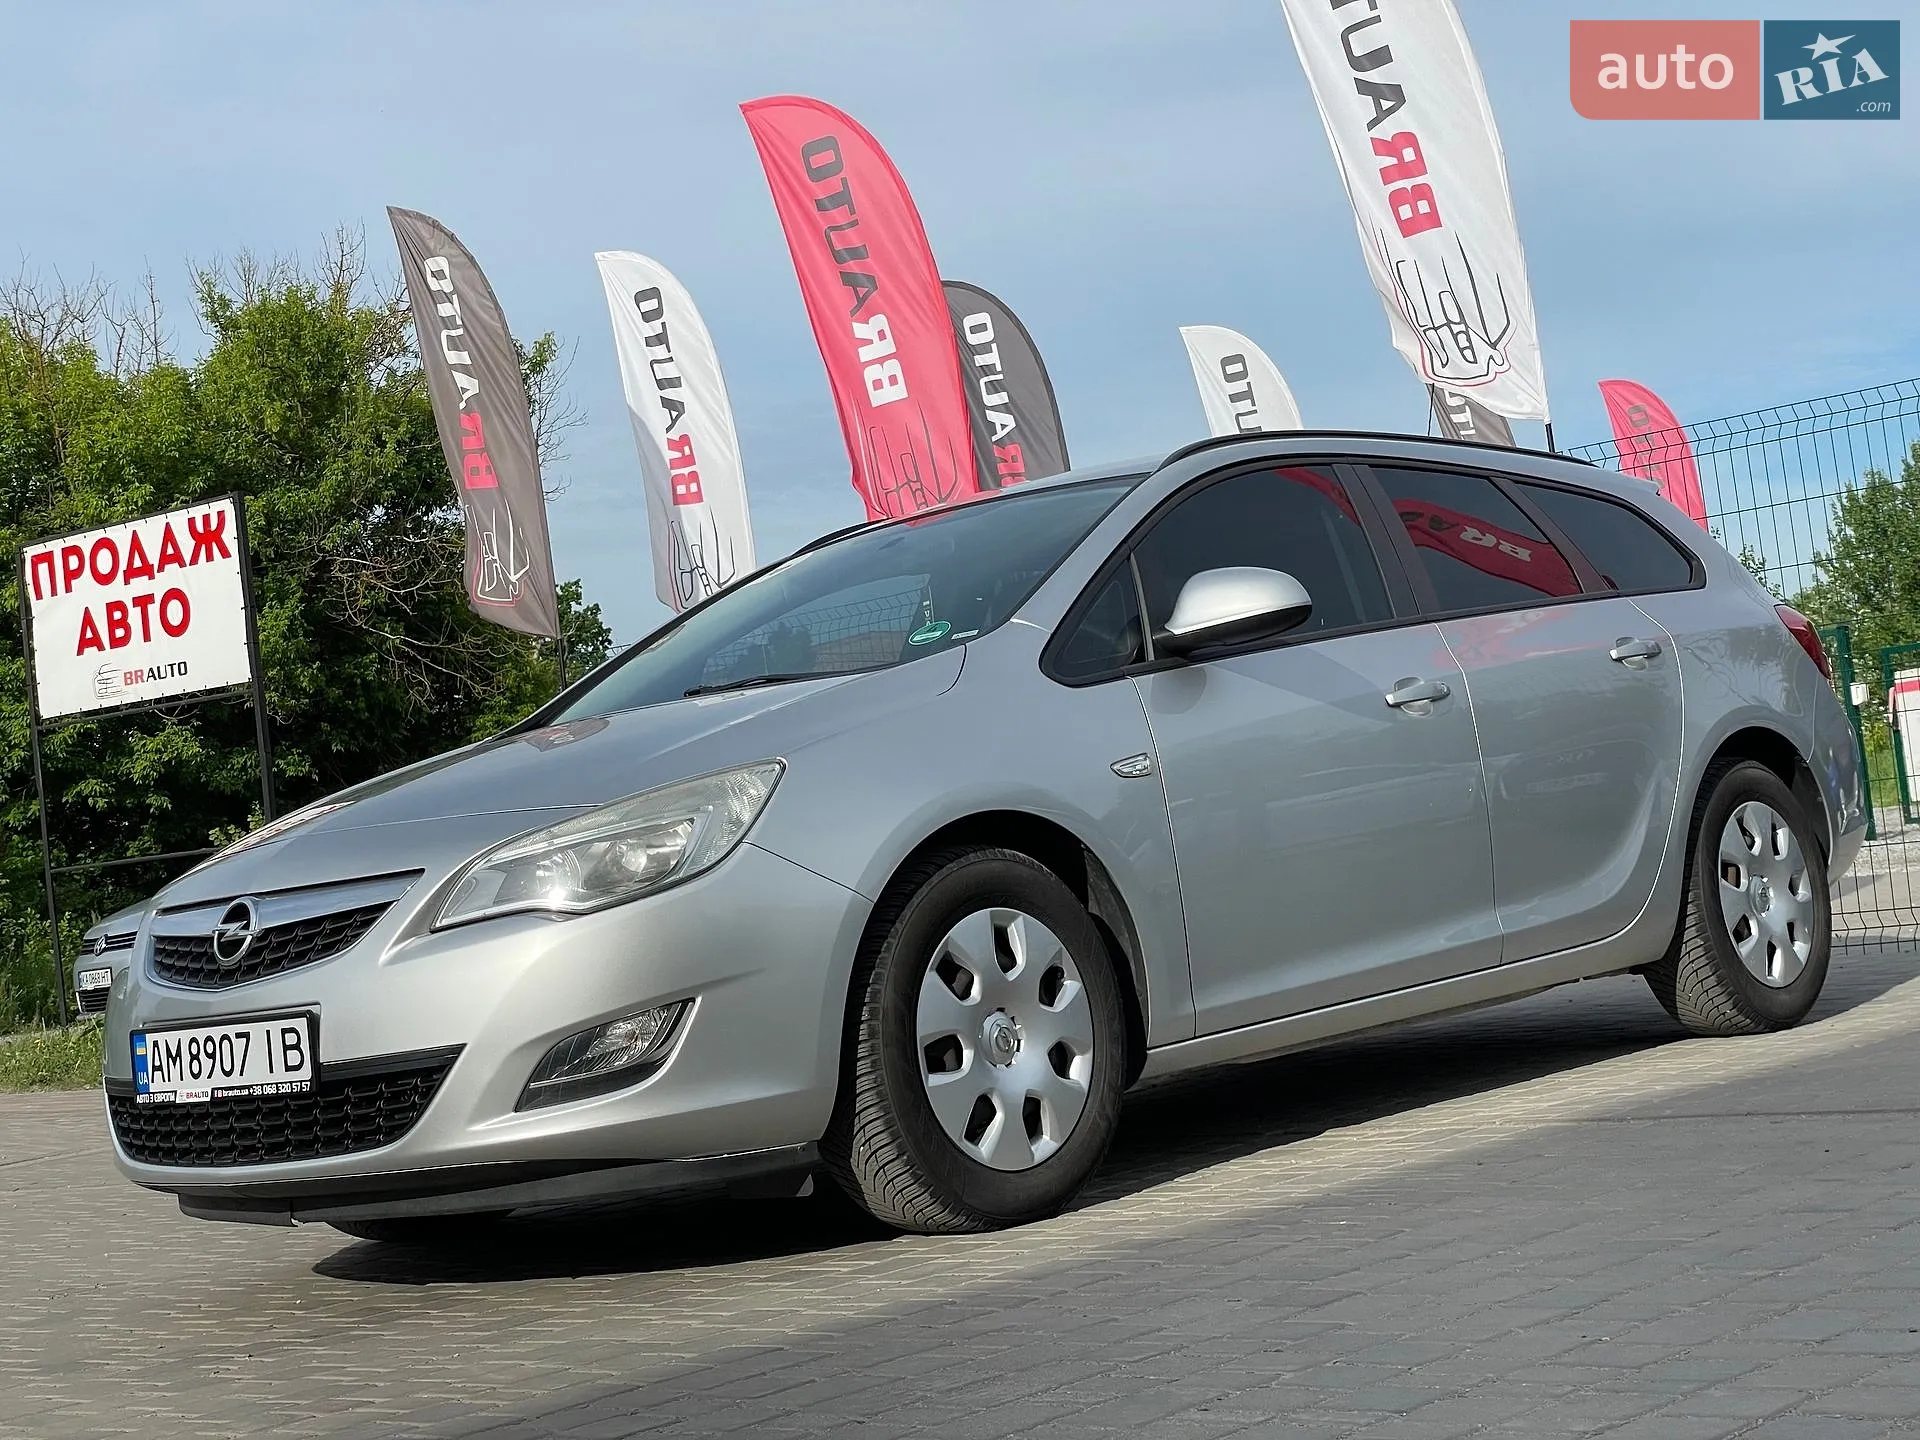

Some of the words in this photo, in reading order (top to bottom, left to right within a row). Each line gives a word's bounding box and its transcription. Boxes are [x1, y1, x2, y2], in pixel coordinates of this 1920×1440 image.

[30, 510, 232, 601] ПРОДАЖ
[76, 587, 191, 657] АВТО
[123, 661, 188, 686] BRAUTO
[138, 1071, 149, 1085] UA
[278, 1082, 291, 1094] 320
[292, 1081, 301, 1093] 57
[302, 1080, 311, 1092] 57
